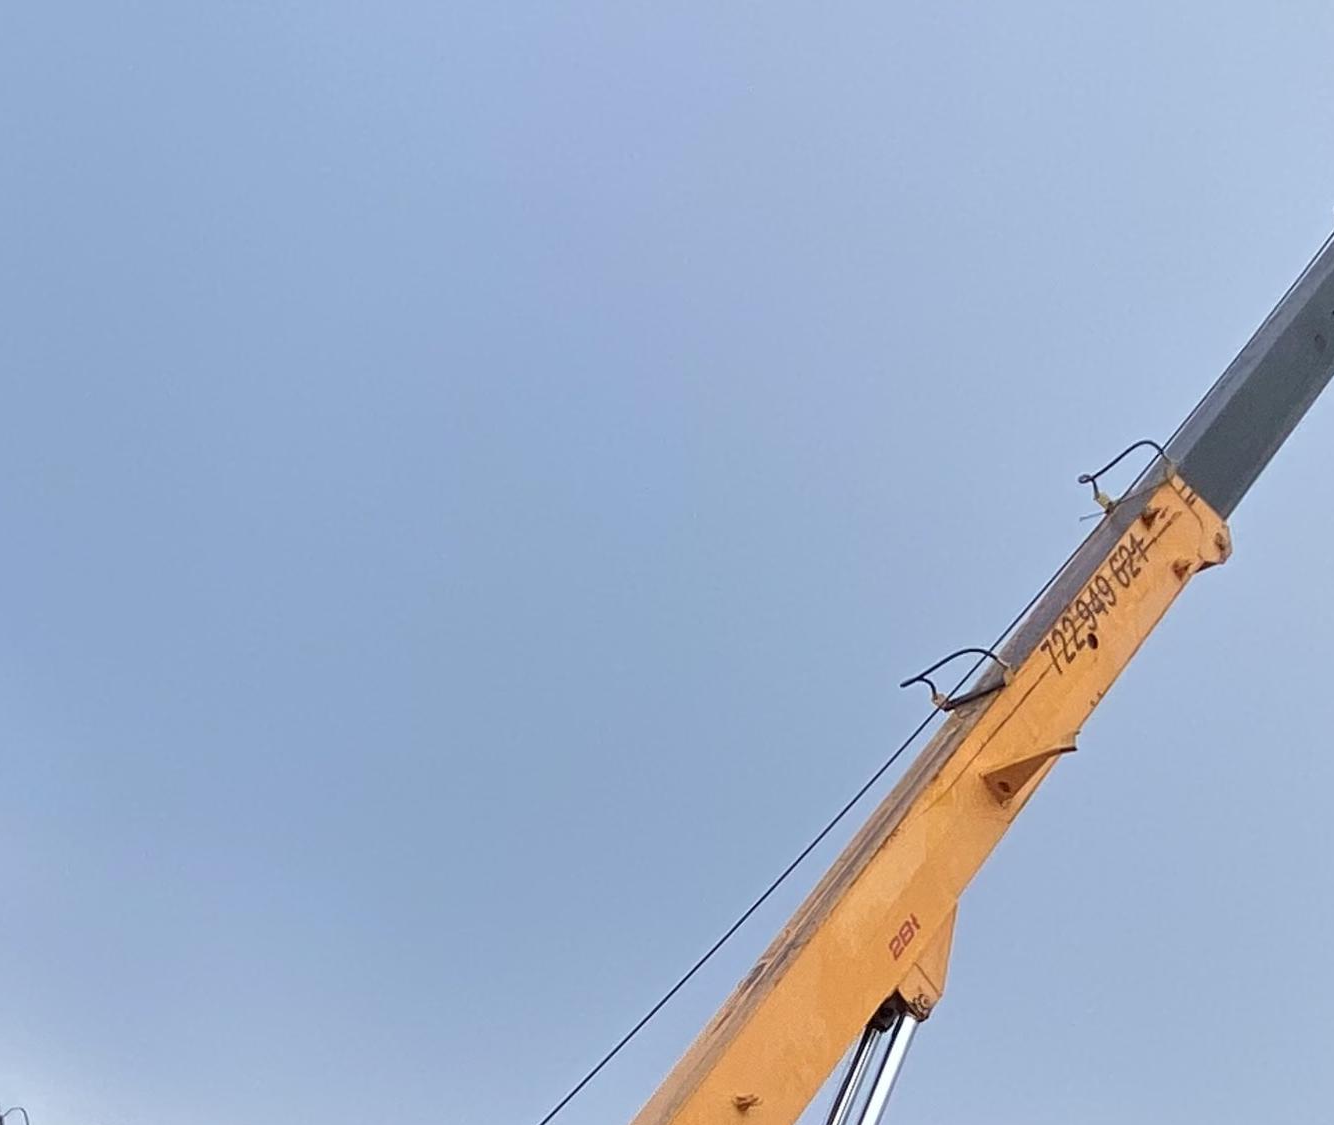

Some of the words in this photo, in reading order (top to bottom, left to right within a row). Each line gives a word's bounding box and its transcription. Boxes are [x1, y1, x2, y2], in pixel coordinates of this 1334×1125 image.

[1040, 616, 1086, 675] 722
[1076, 575, 1116, 631] 949
[1109, 532, 1149, 588] 624
